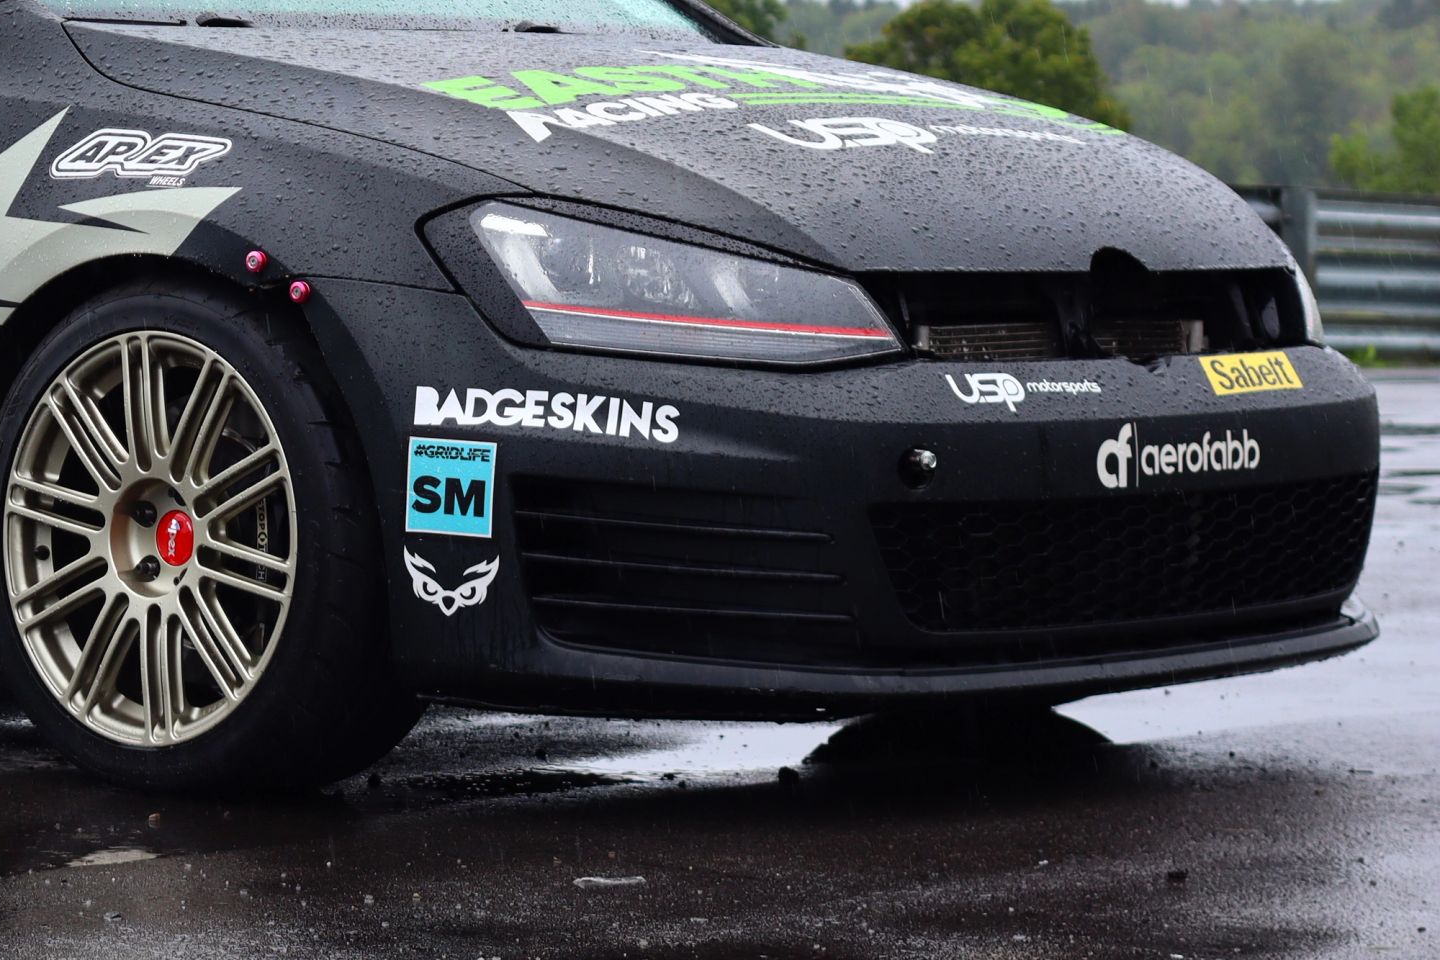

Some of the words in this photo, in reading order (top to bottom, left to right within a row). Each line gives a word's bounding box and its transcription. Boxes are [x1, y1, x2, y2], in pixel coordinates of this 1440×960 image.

[506, 93, 739, 143] RACING
[148, 175, 186, 187] WHEELS
[945, 372, 1026, 413] USP
[1026, 379, 1102, 394] motorsports
[1210, 357, 1295, 391] Sabelt
[413, 386, 681, 444] BADGESKINS
[413, 443, 492, 463] #GRIDLIFE
[1140, 428, 1261, 477] aerofabb
[411, 474, 487, 519] SM
